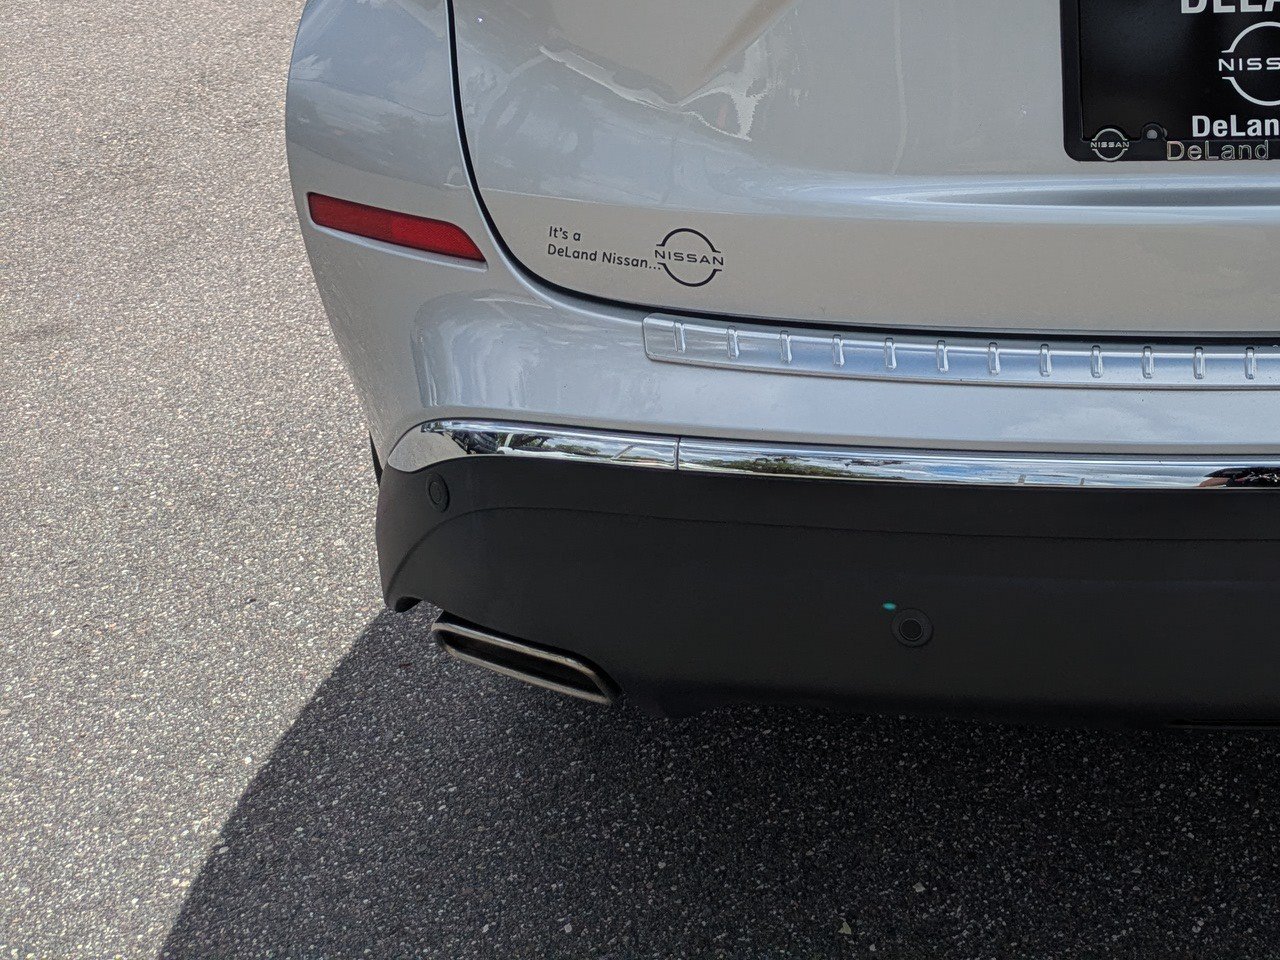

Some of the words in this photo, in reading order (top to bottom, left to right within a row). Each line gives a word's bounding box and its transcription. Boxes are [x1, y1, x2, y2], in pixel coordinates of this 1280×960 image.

[1166, 139, 1269, 161] DeLand
[549, 225, 568, 240] It's
[573, 232, 581, 242] a
[547, 243, 598, 262] DeLand
[654, 249, 724, 266] NISSAN
